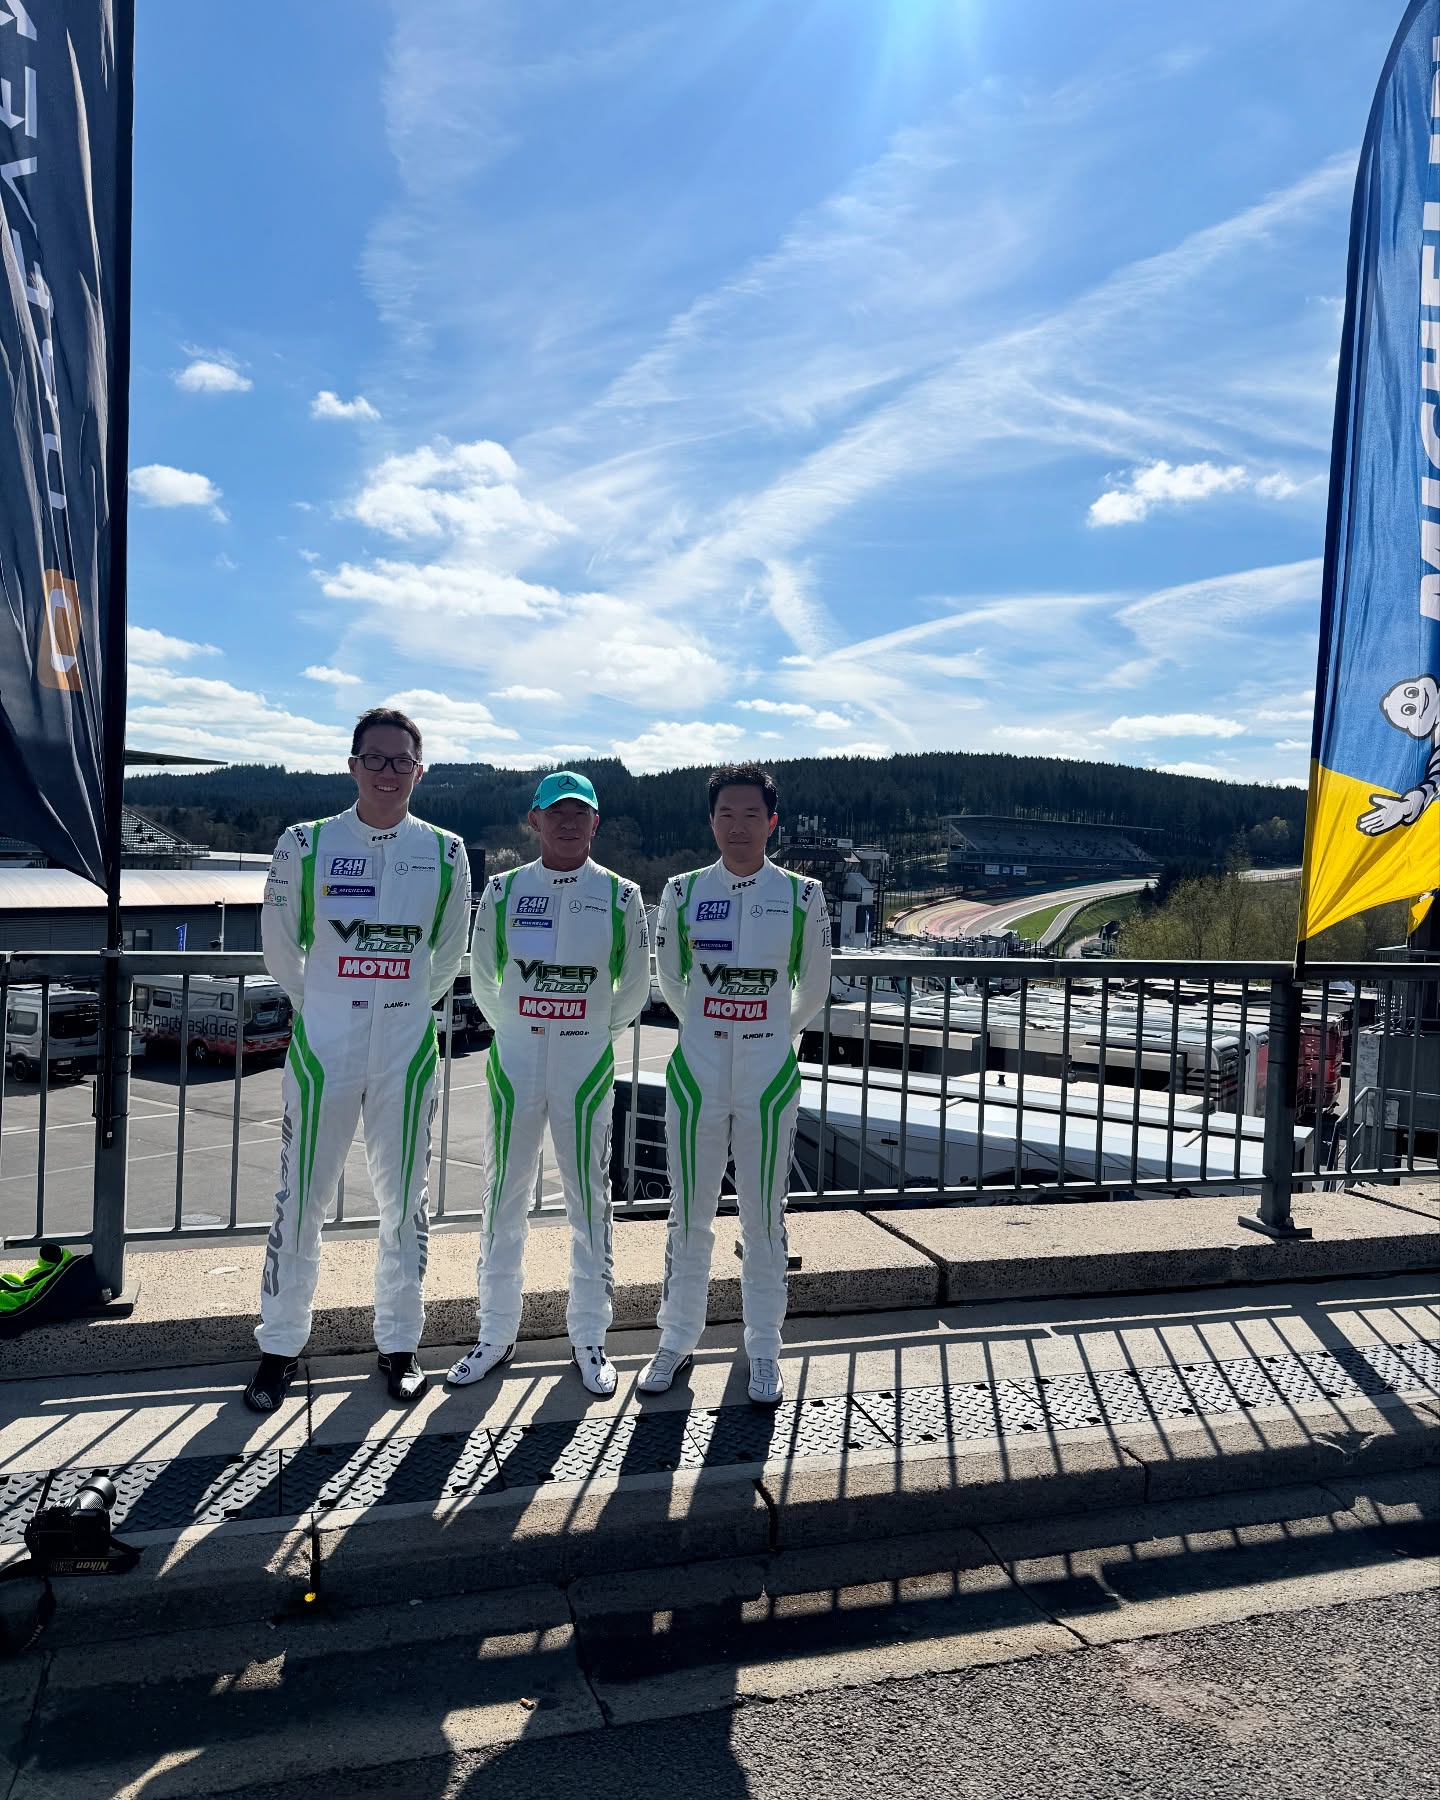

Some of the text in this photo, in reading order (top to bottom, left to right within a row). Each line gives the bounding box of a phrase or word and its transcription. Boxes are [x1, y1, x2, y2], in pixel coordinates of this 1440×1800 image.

[371, 831, 398, 842] HRX
[333, 859, 364, 871] 24H
[552, 876, 578, 885] HRX
[731, 878, 757, 891] HRX
[519, 897, 548, 909] 24H
[699, 901, 730, 915] 24H
[341, 959, 407, 977] MOTUL
[521, 999, 584, 1017] MOTUL
[706, 1000, 764, 1019] MOTUL
[75, 1561, 109, 1571] Nikon
